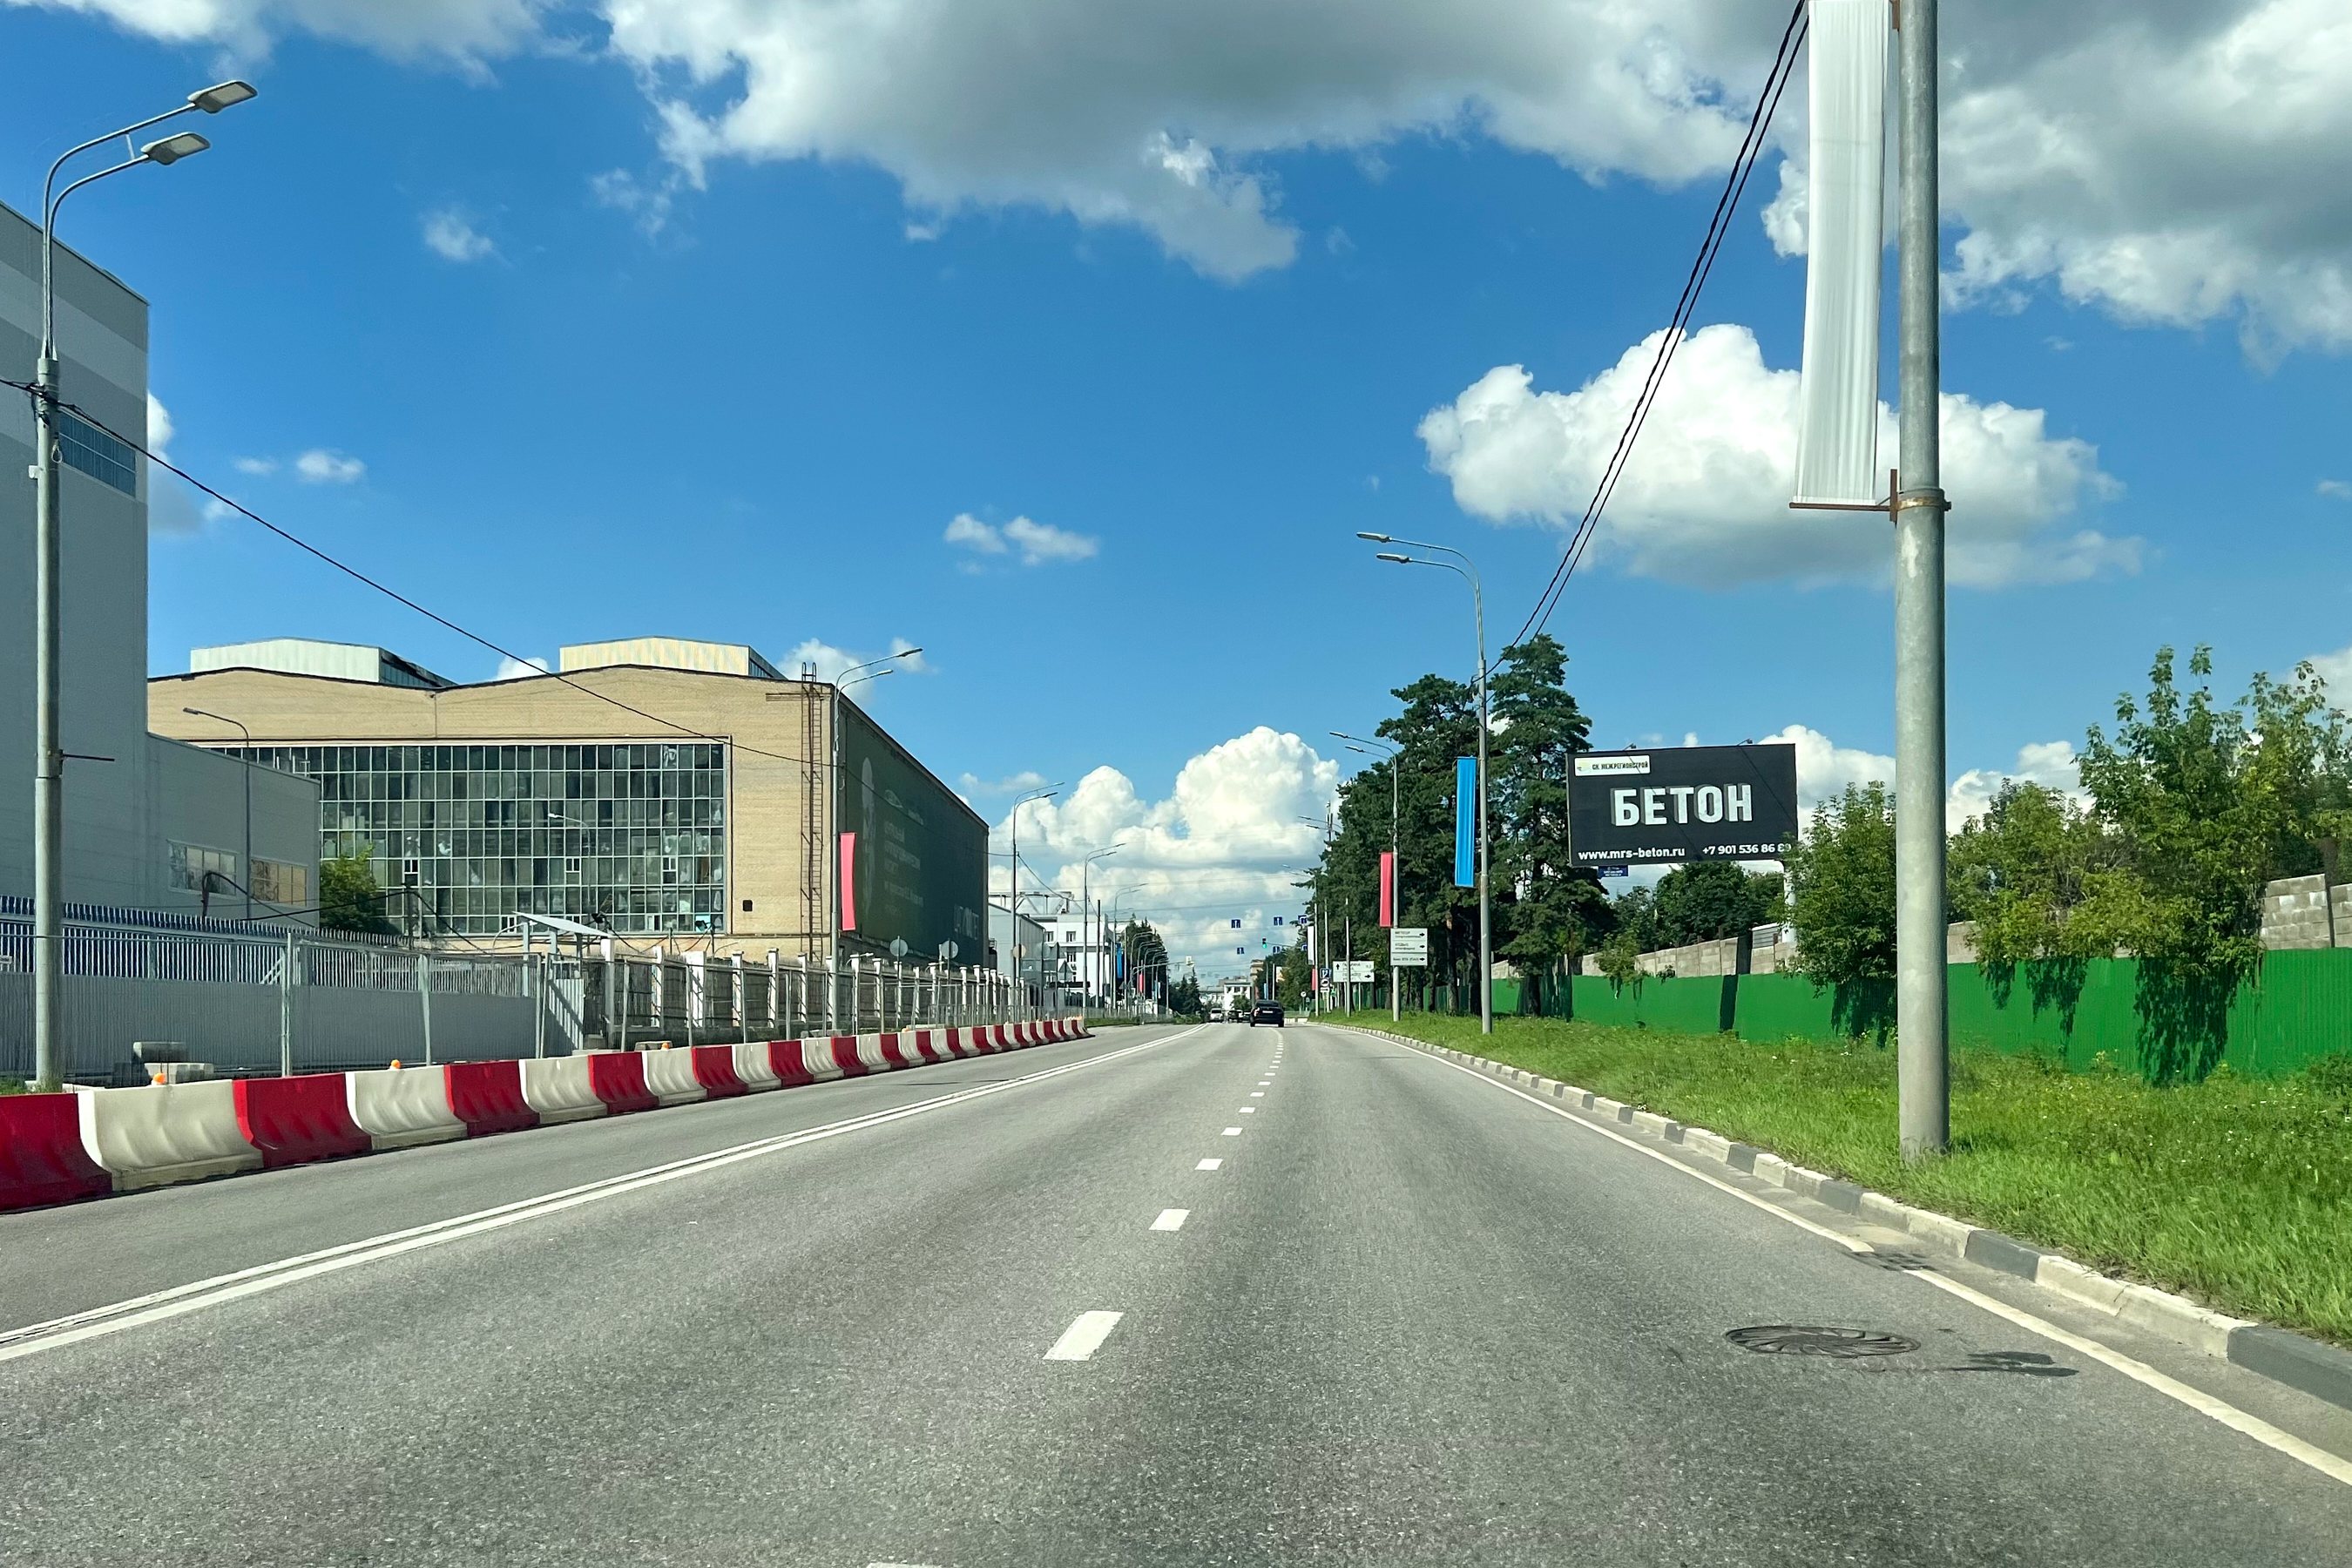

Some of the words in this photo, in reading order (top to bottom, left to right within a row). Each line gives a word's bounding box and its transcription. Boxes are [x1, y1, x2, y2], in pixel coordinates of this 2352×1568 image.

[1611, 783, 1753, 827] БЕТОН
[1578, 847, 1686, 861] www.mrs-beton.ru
[1702, 845, 1716, 855] +7
[1718, 845, 1736, 855] 901
[1739, 844, 1759, 854] 536
[1761, 843, 1775, 853] 86
